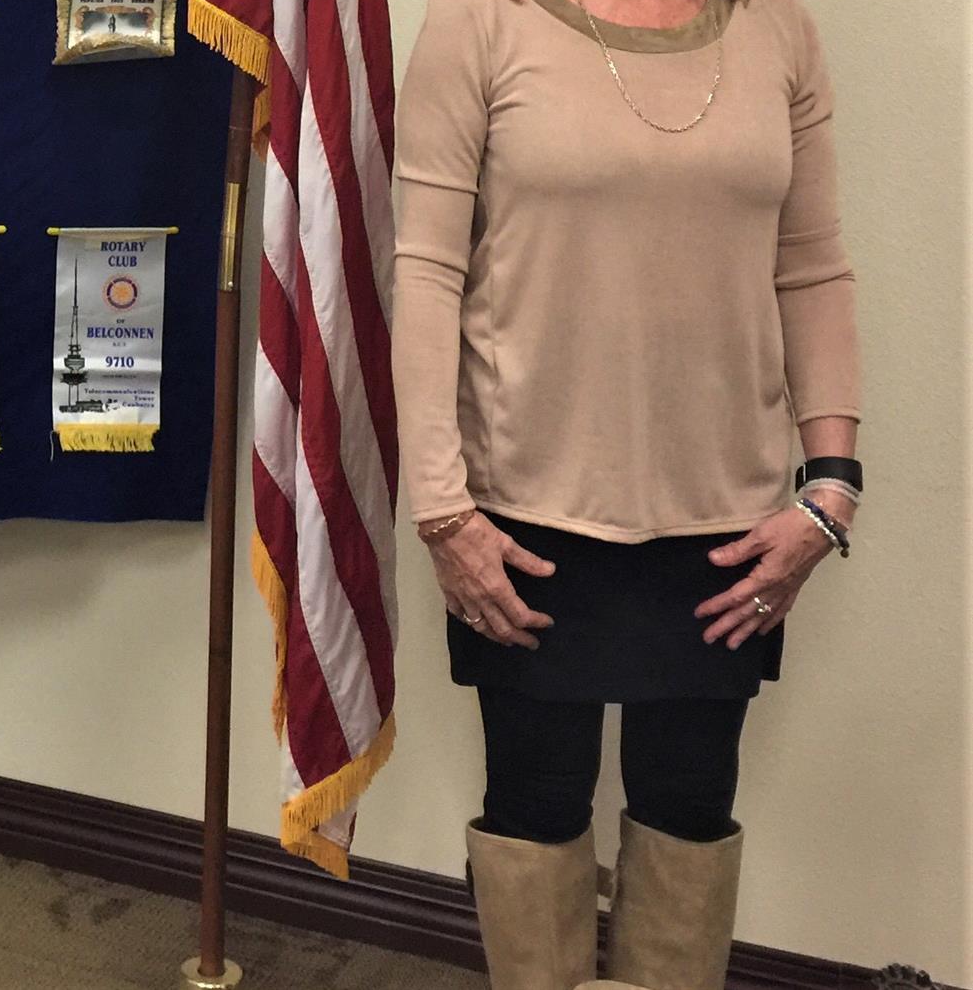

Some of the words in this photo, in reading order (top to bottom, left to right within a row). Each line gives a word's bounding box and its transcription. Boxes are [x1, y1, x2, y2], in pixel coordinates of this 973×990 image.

[100, 241, 147, 252] ROTARY
[108, 255, 138, 267] CLUB
[86, 327, 154, 339] BELCONNEN
[105, 357, 135, 368] 9710
